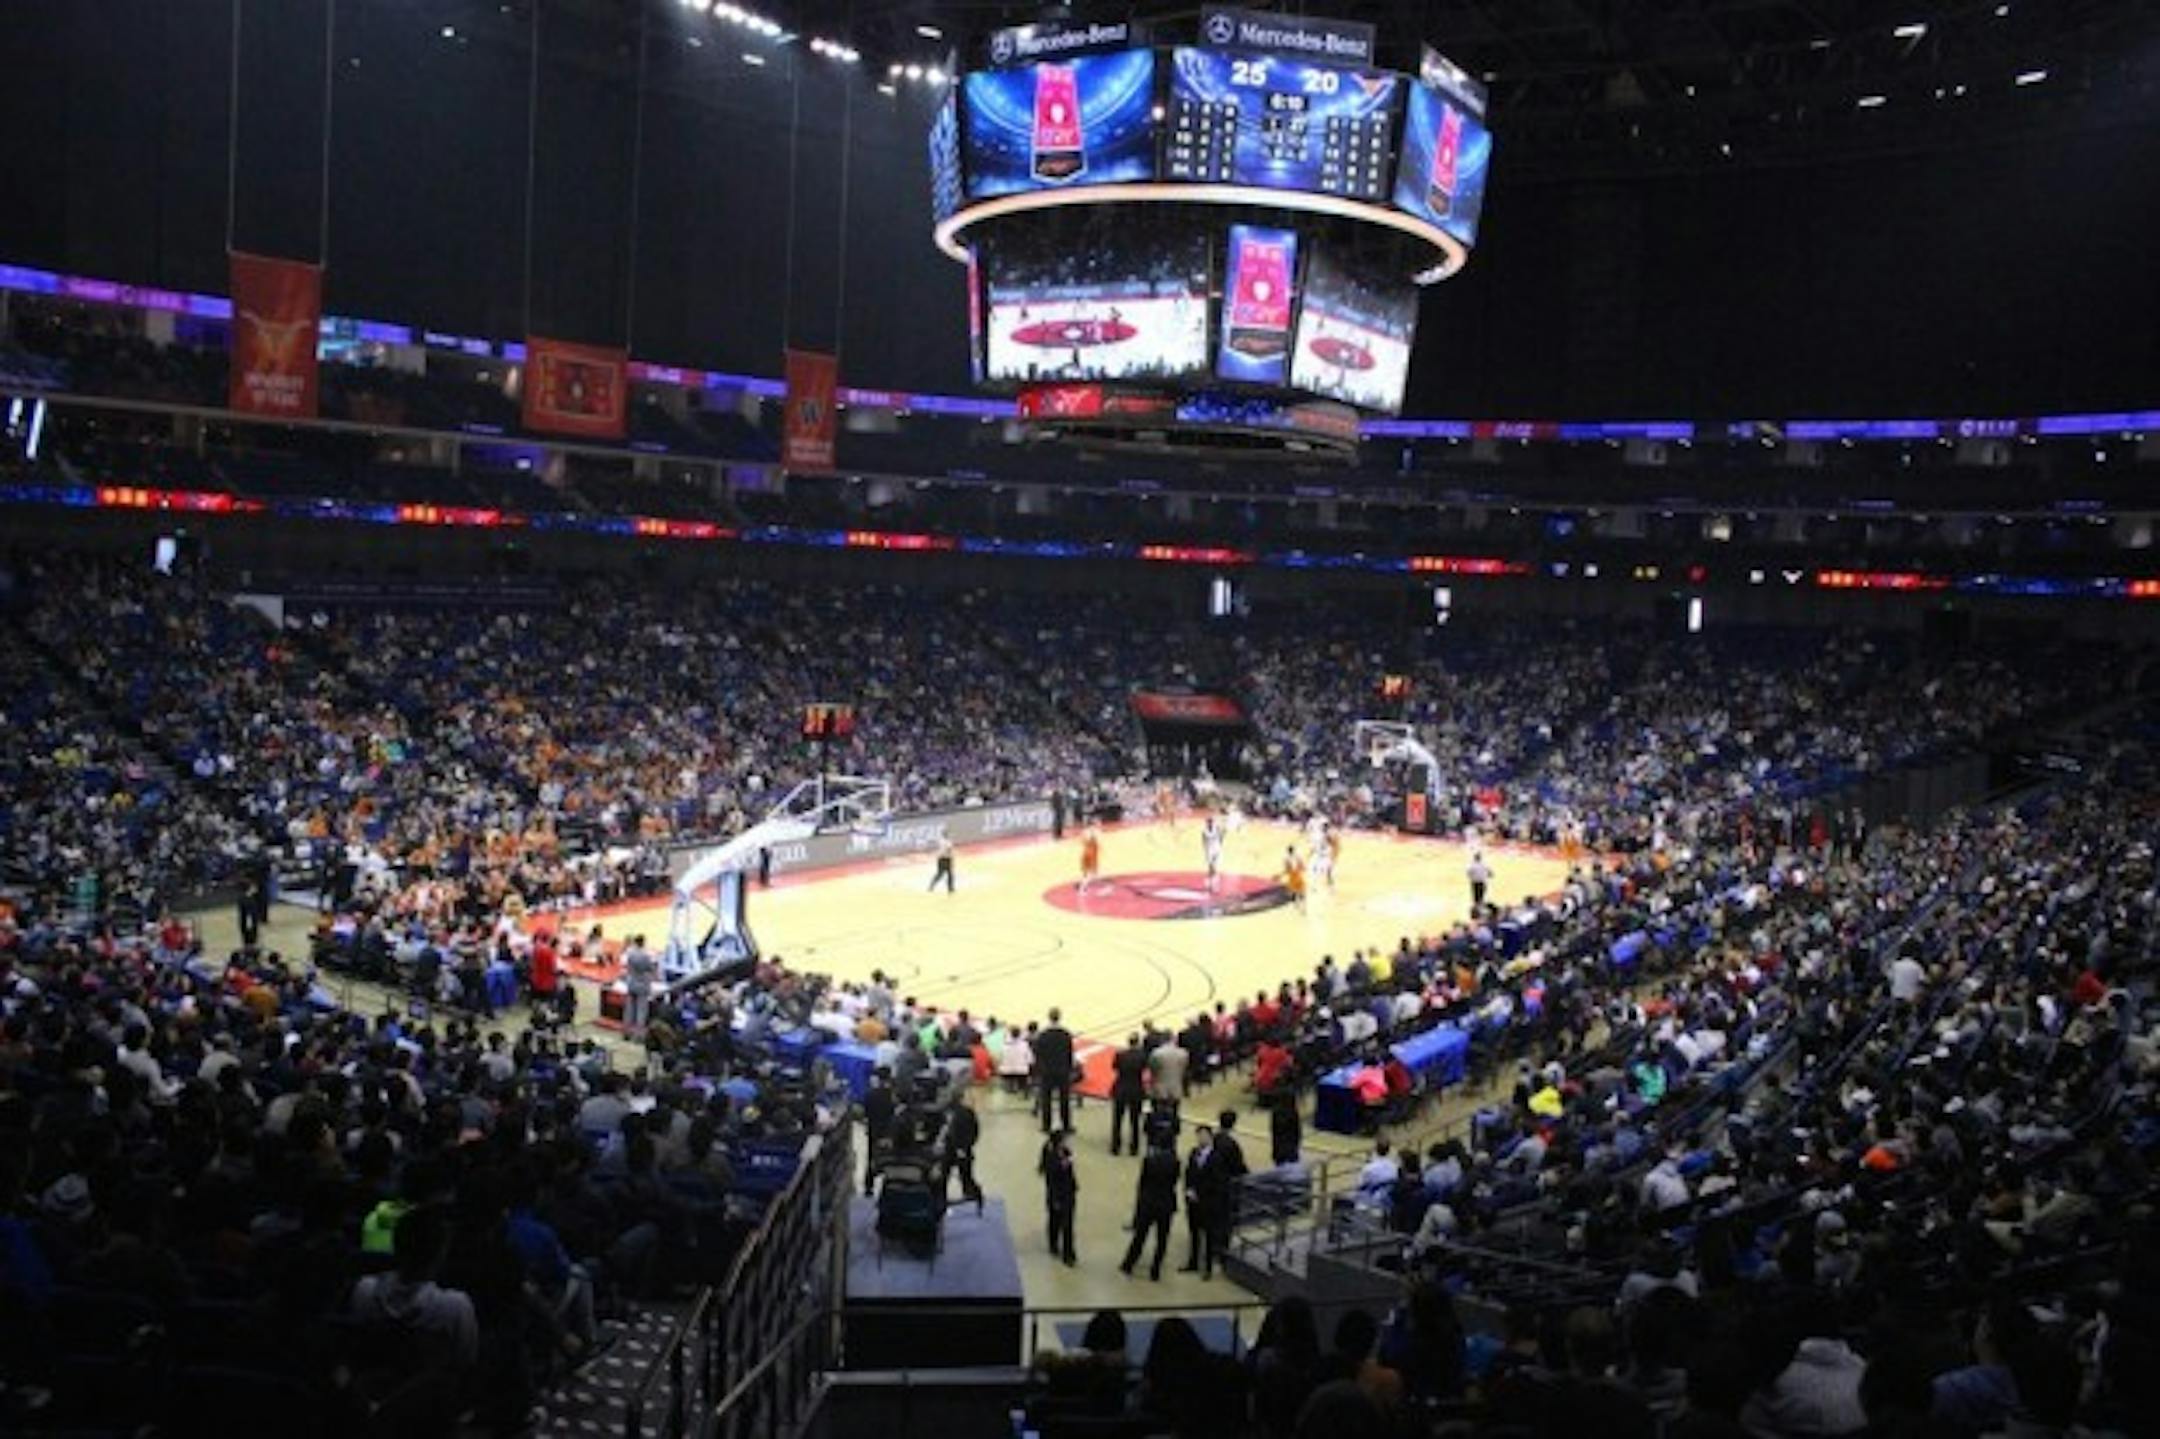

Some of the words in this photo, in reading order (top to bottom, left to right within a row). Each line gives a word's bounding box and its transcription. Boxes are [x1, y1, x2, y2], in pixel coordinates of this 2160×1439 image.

[1239, 22, 1367, 56] Mercedes-Benz
[1230, 60, 1267, 87] 25
[1302, 68, 1339, 95] 20
